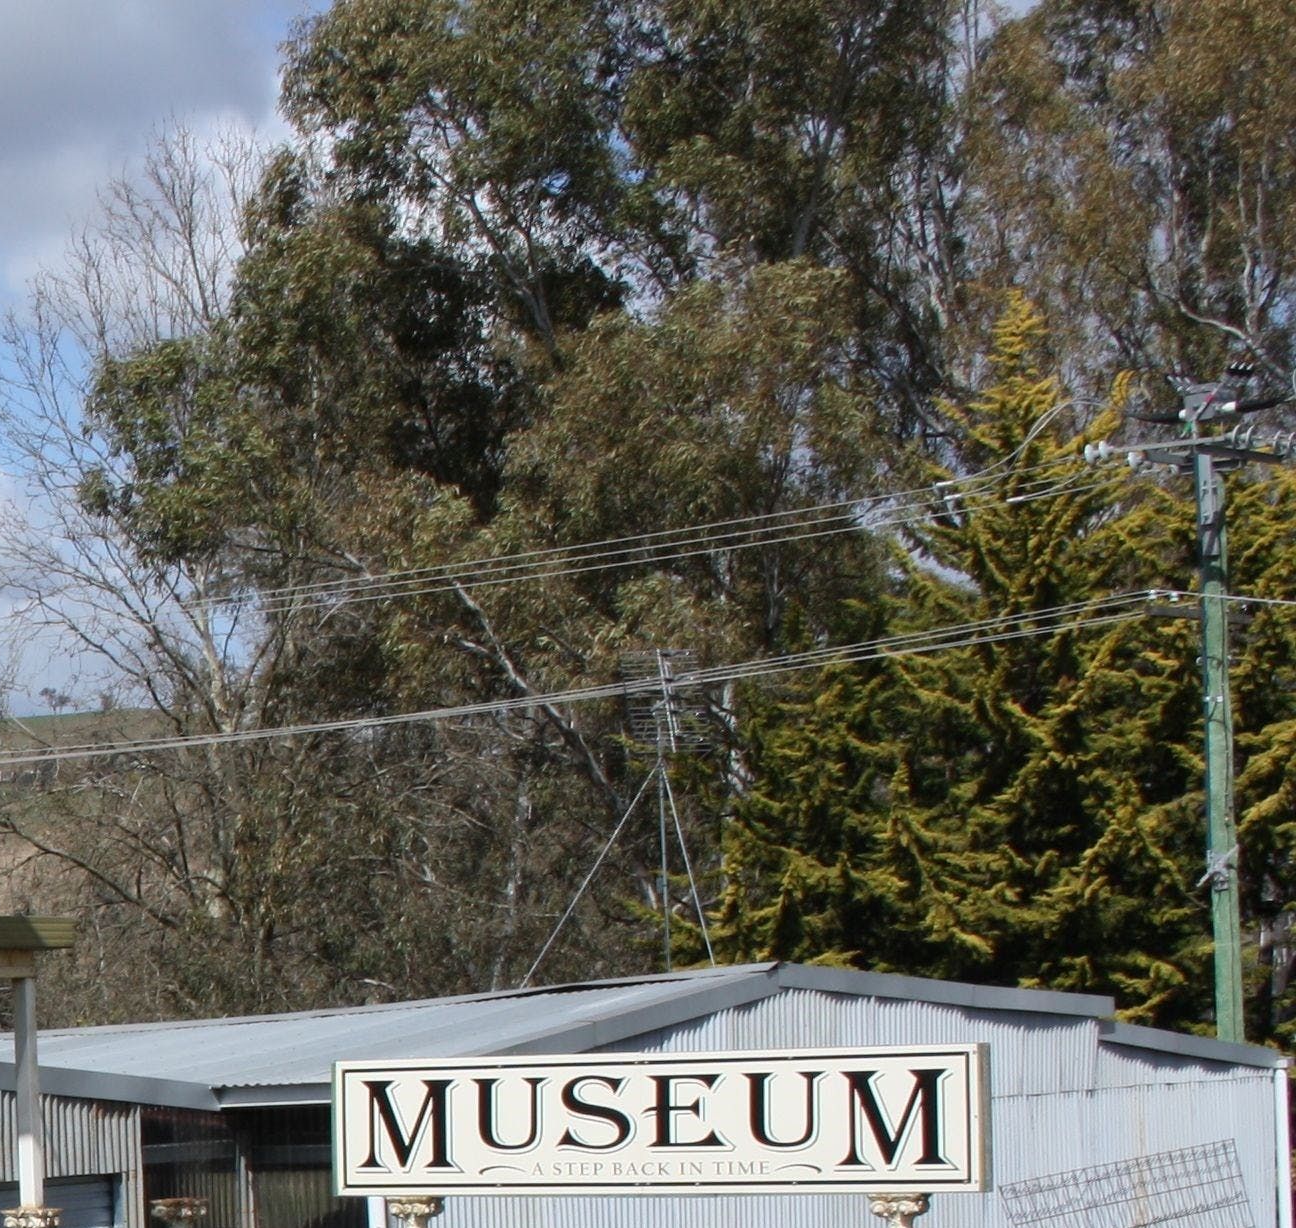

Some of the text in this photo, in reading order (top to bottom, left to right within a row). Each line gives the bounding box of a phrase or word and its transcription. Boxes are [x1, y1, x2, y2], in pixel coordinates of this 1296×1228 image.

[354, 1067, 959, 1174] MUSEUM
[531, 1160, 771, 1176] A STEP BACK IN TIME
